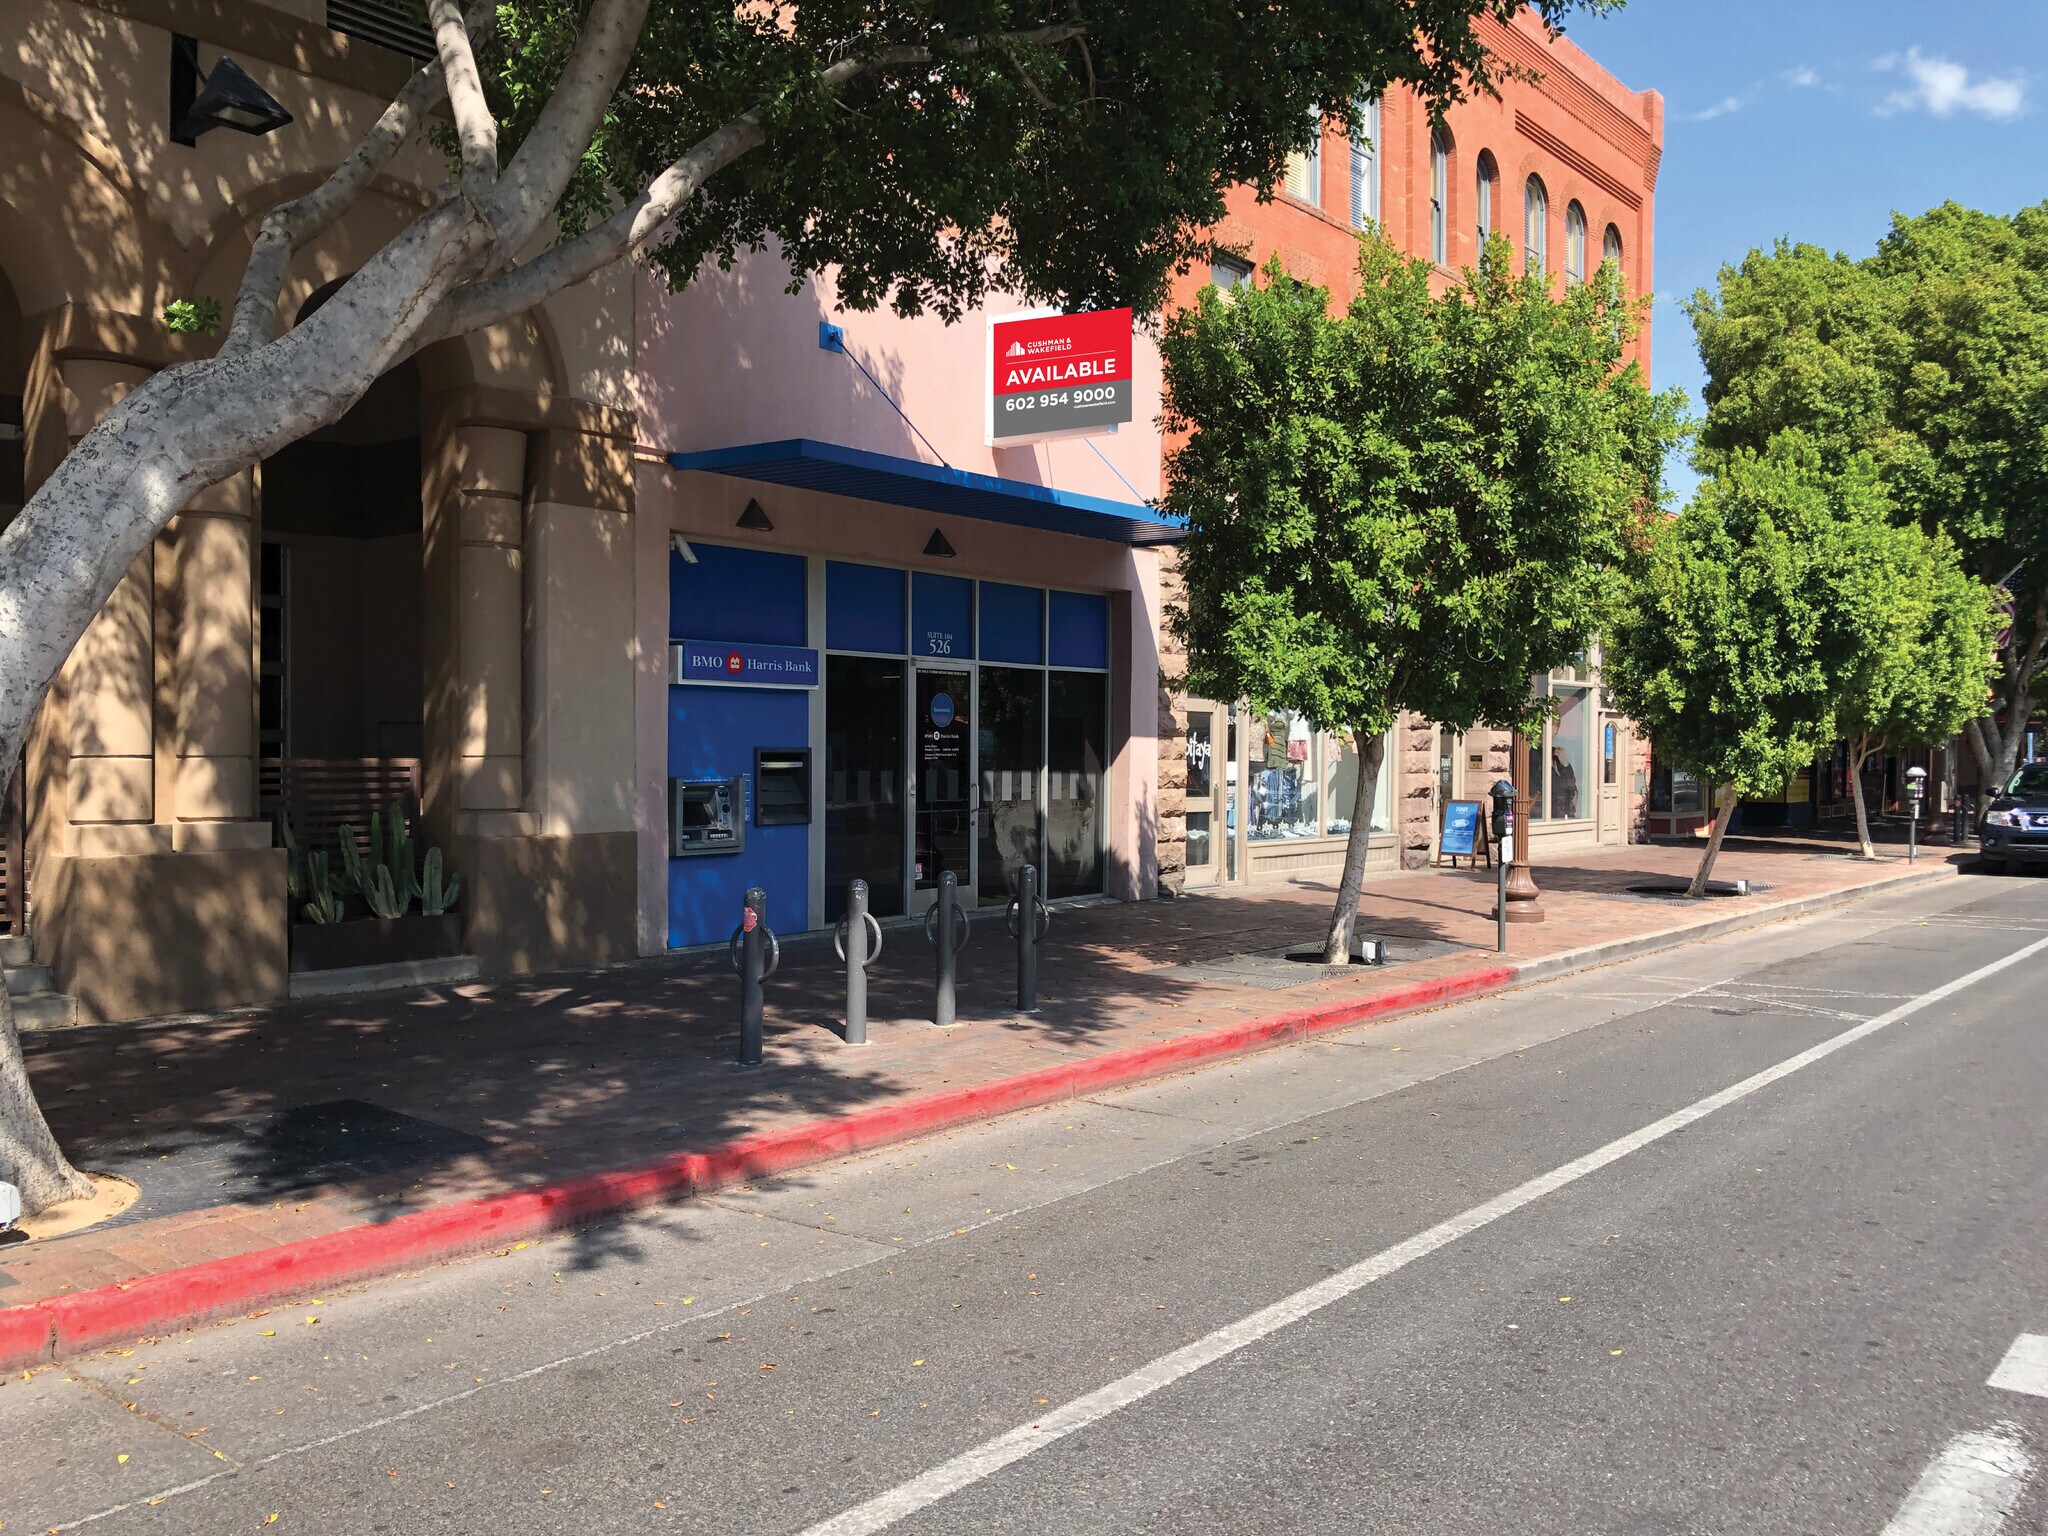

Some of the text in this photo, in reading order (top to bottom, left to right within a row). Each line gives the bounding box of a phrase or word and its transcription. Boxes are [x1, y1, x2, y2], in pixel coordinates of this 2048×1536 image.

[1027, 338, 1064, 349] CUSHMAN
[1027, 344, 1072, 355] WAKEFIELD
[1006, 358, 1116, 386] AVAILABLE
[1005, 386, 1116, 412] 602 954 9000
[927, 631, 944, 640] SUITE
[929, 639, 951, 655] 526
[692, 655, 812, 673] BMO Harris Bank
